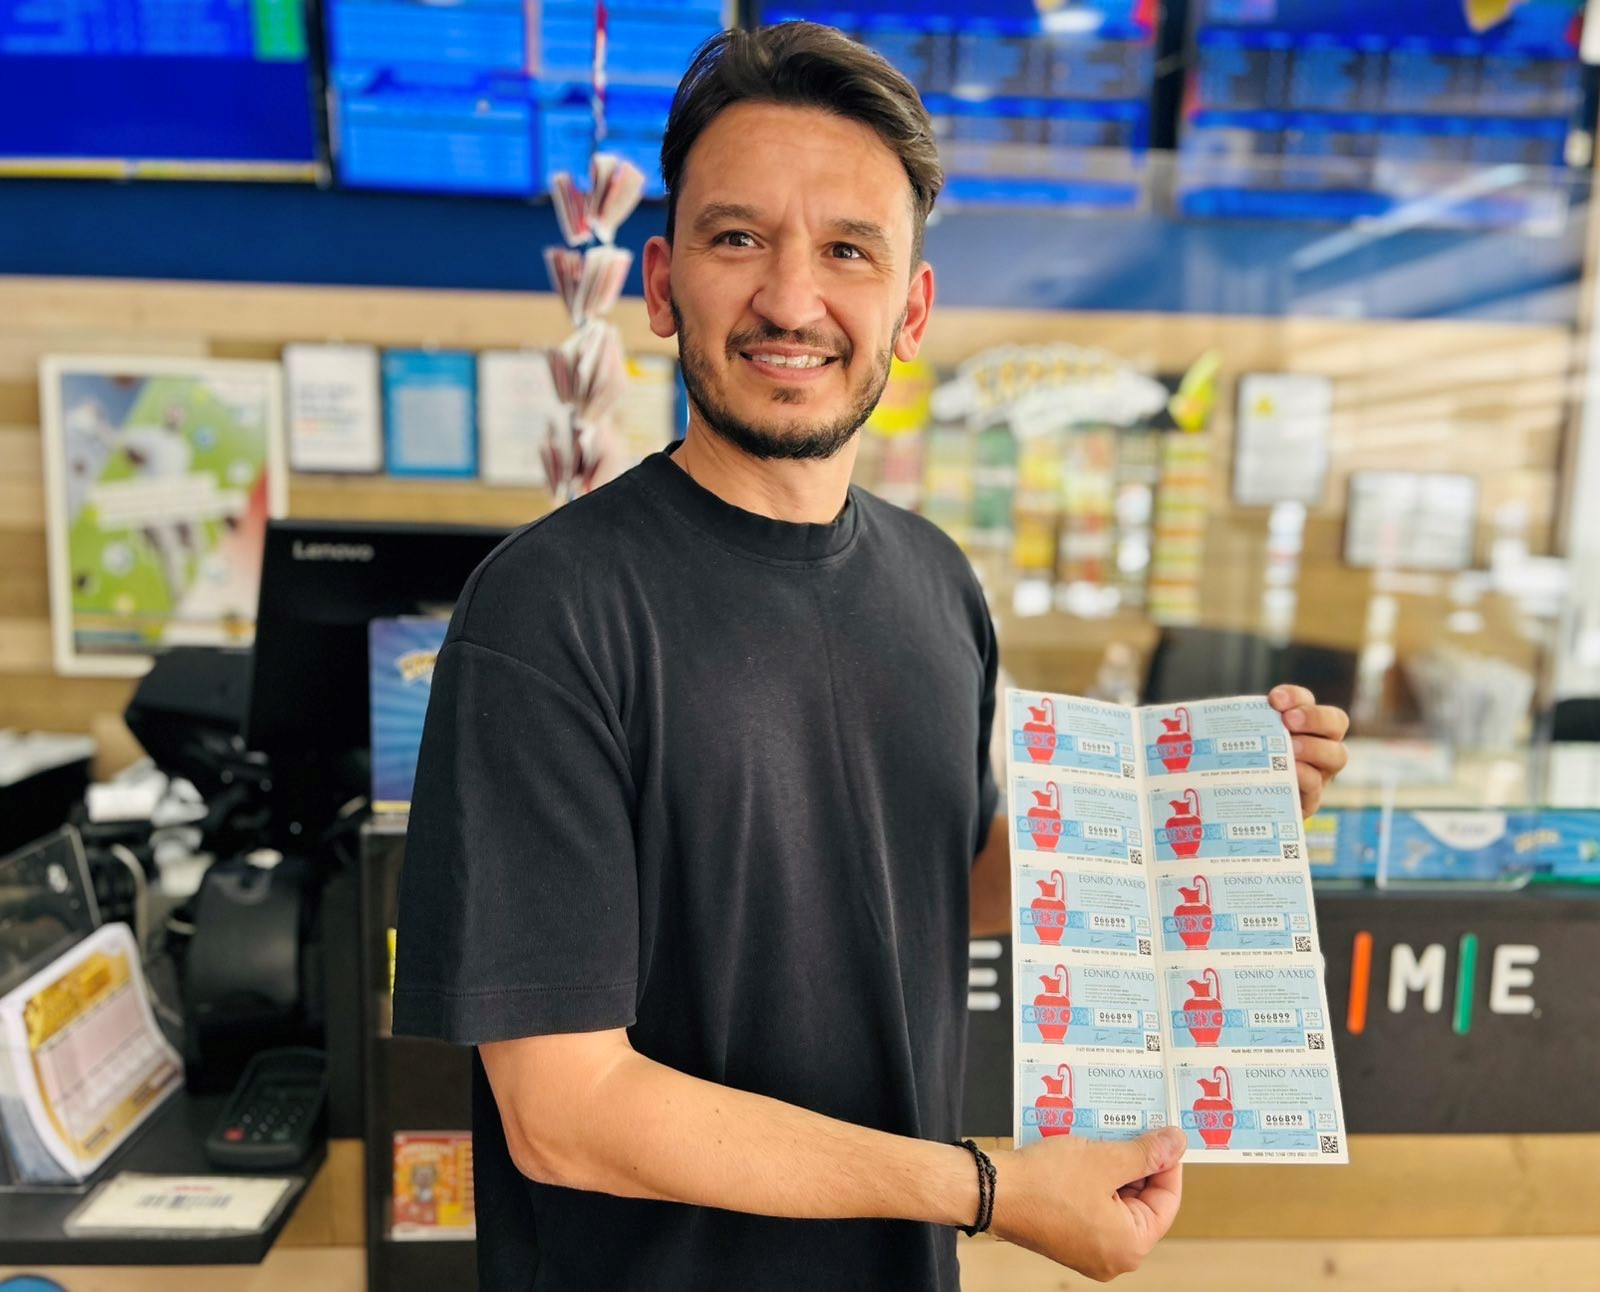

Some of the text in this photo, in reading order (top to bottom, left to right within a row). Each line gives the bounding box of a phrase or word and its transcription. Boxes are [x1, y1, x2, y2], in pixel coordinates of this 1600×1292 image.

[292, 538, 375, 562] Lenovo
[1072, 786, 1138, 801] ΕΘΝΙΚΟ ΛΑΧΕΙΟ
[1213, 786, 1292, 797] ΕΘΝΙΚΟ ΛΑΧΕΙΟ
[1088, 825, 1118, 834] 066899
[1079, 874, 1146, 889] ΕΘΝΙΚΟ ΛΑΧΕΙΟ
[1223, 875, 1303, 885] ΕΘΝΙΚΟ ΛΑΧΕΙΟ
[1094, 916, 1125, 924] 066899
[1083, 969, 1155, 981] ΕΘΝΙΚΟ ΛΑΧΕΙΟ
[1234, 969, 1315, 979] ΕΘΝΙΚΟ ΛΑΧΕΙΟ
[1099, 1012, 1132, 1020] 066899
[1254, 1012, 1290, 1020] 066899
[1088, 1067, 1164, 1080] ΕΘΝΙΚΟ ΛΑΧΕΙΟ
[1245, 1068, 1329, 1078] ΕΘΝΙΚΟ ΛΑΧΕΙΟ
[1103, 1114, 1137, 1122] 066899
[1265, 1114, 1303, 1122] 066899
